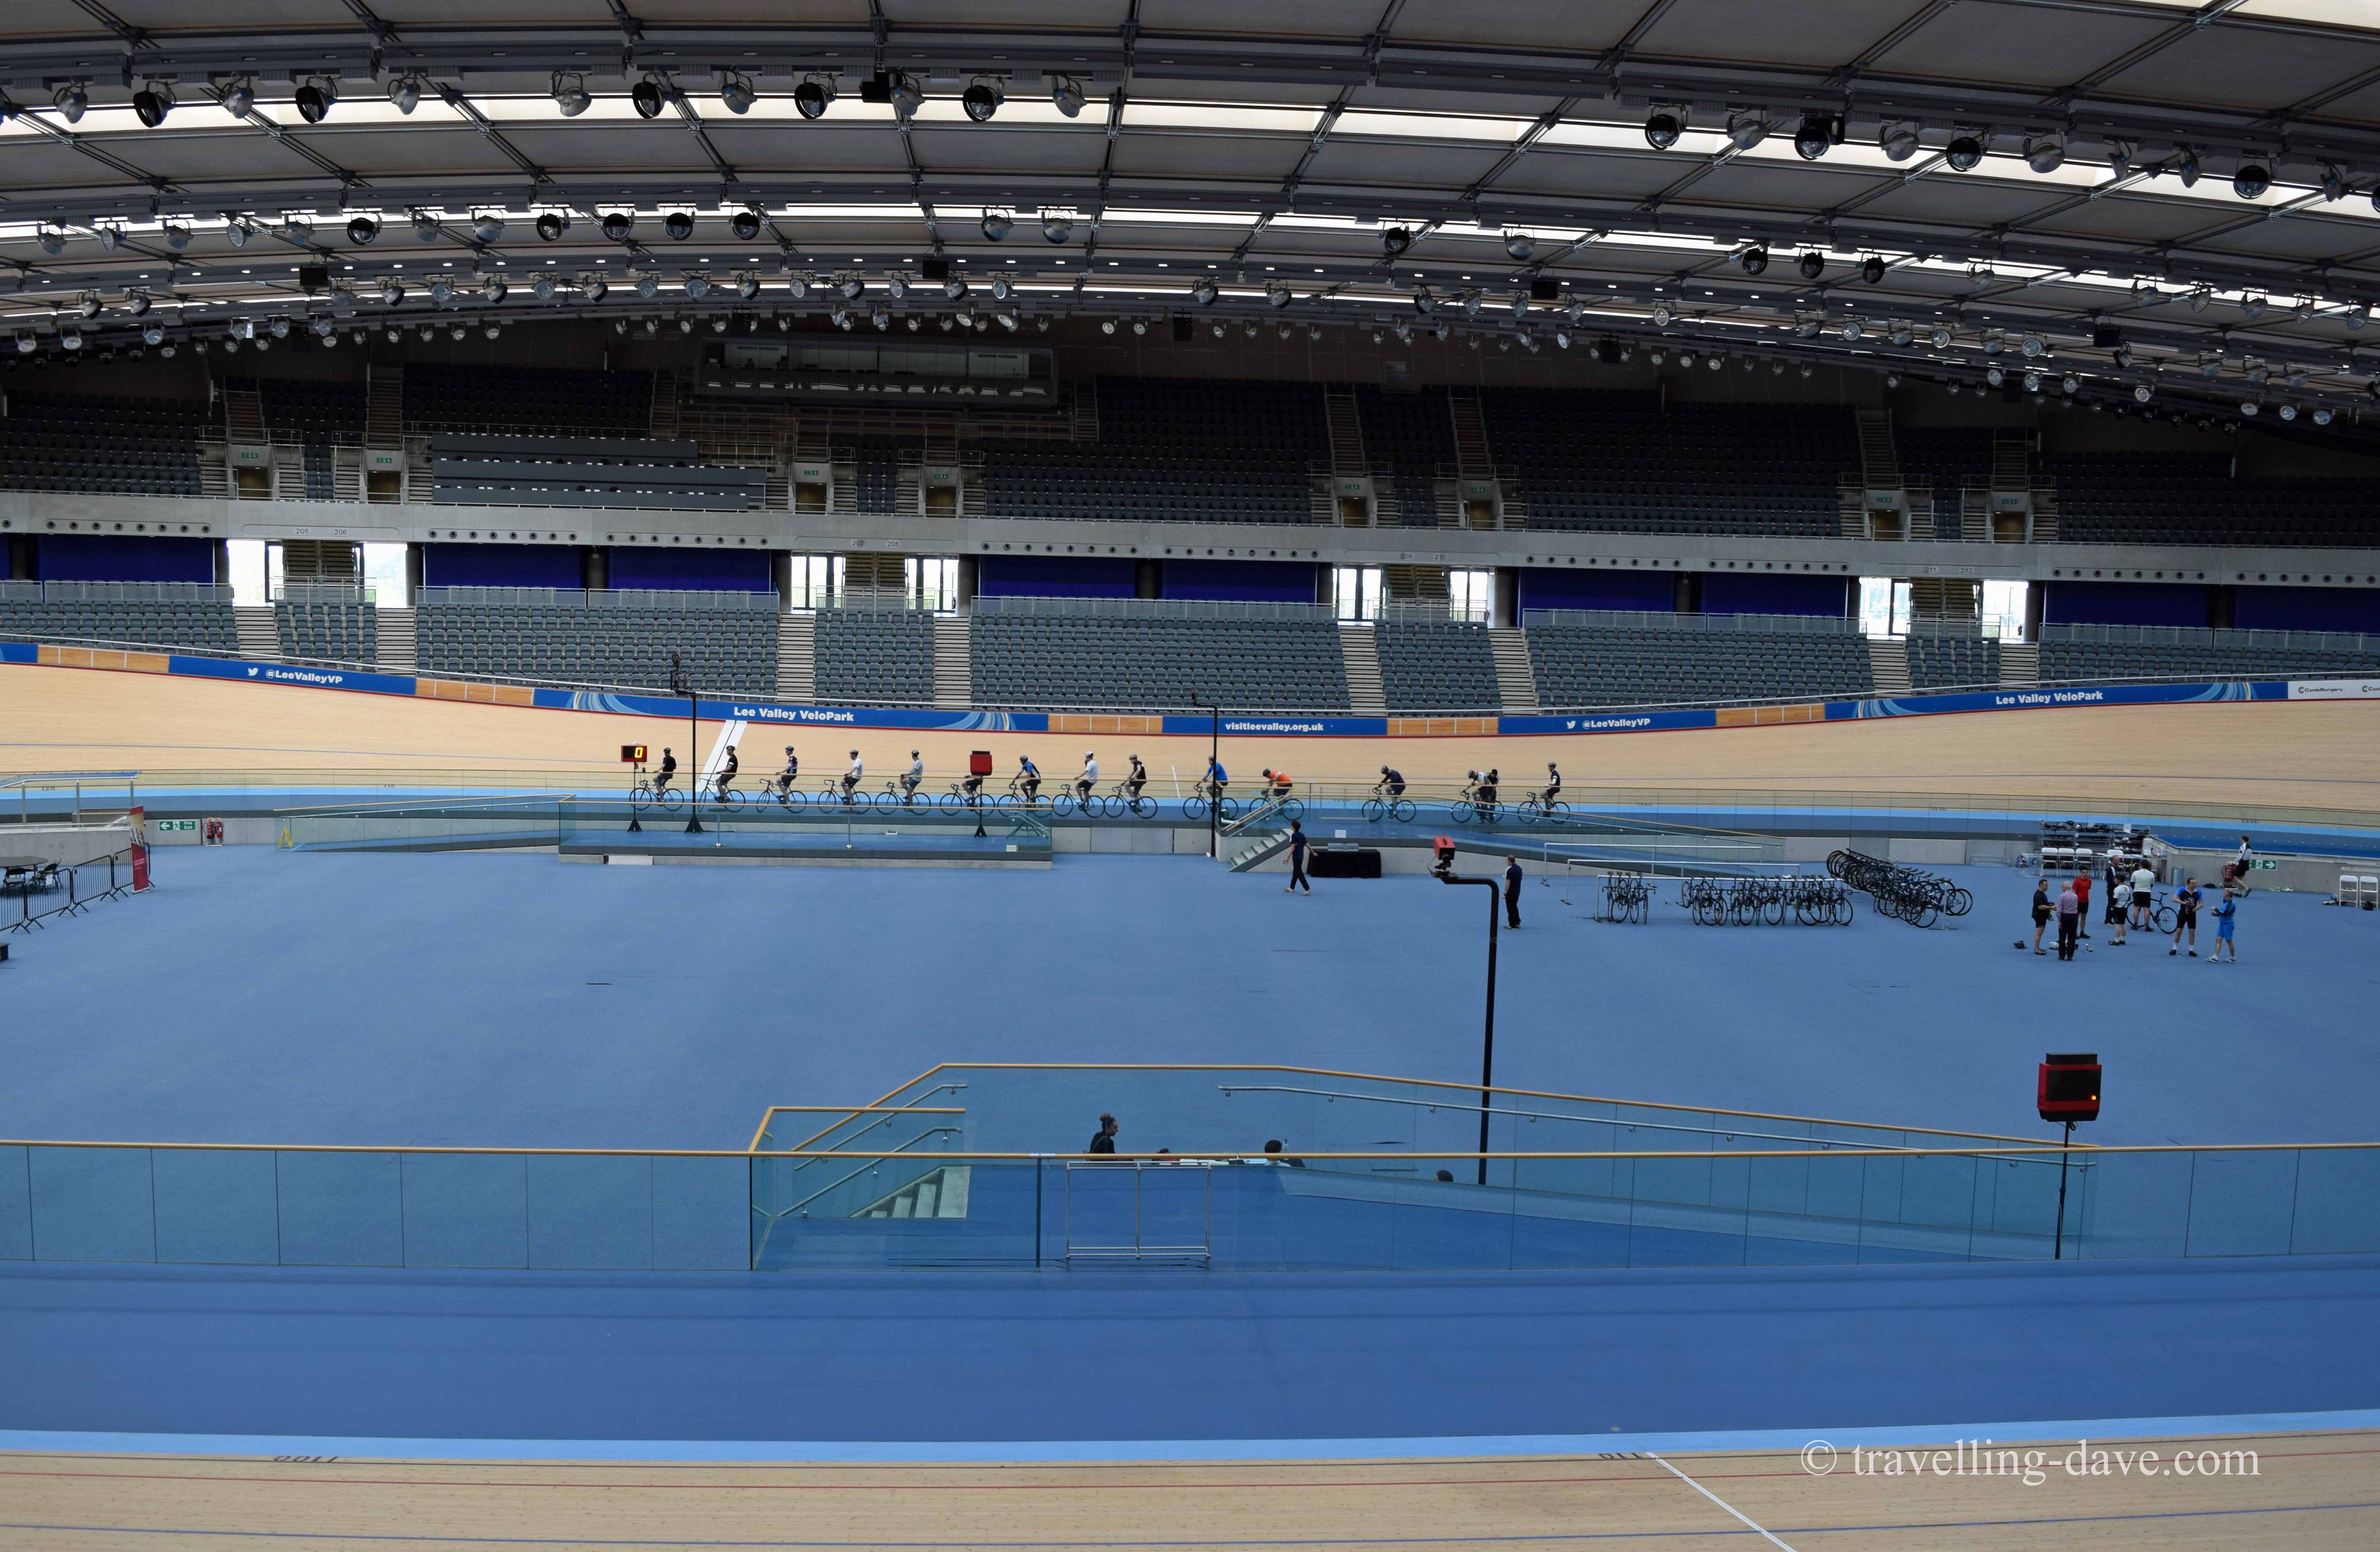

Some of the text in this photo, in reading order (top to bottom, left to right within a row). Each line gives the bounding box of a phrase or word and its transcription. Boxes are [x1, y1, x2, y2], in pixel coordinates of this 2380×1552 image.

[266, 669, 343, 684] @LeeValleyVP
[1996, 691, 2103, 705] Lee Valley VeloPark
[734, 707, 854, 721] Lee Valley VeloPark
[1225, 722, 1324, 732] visitleevalley.org.uk
[1582, 718, 1651, 729] @LeeValleyVP
[635, 747, 643, 758] 0
